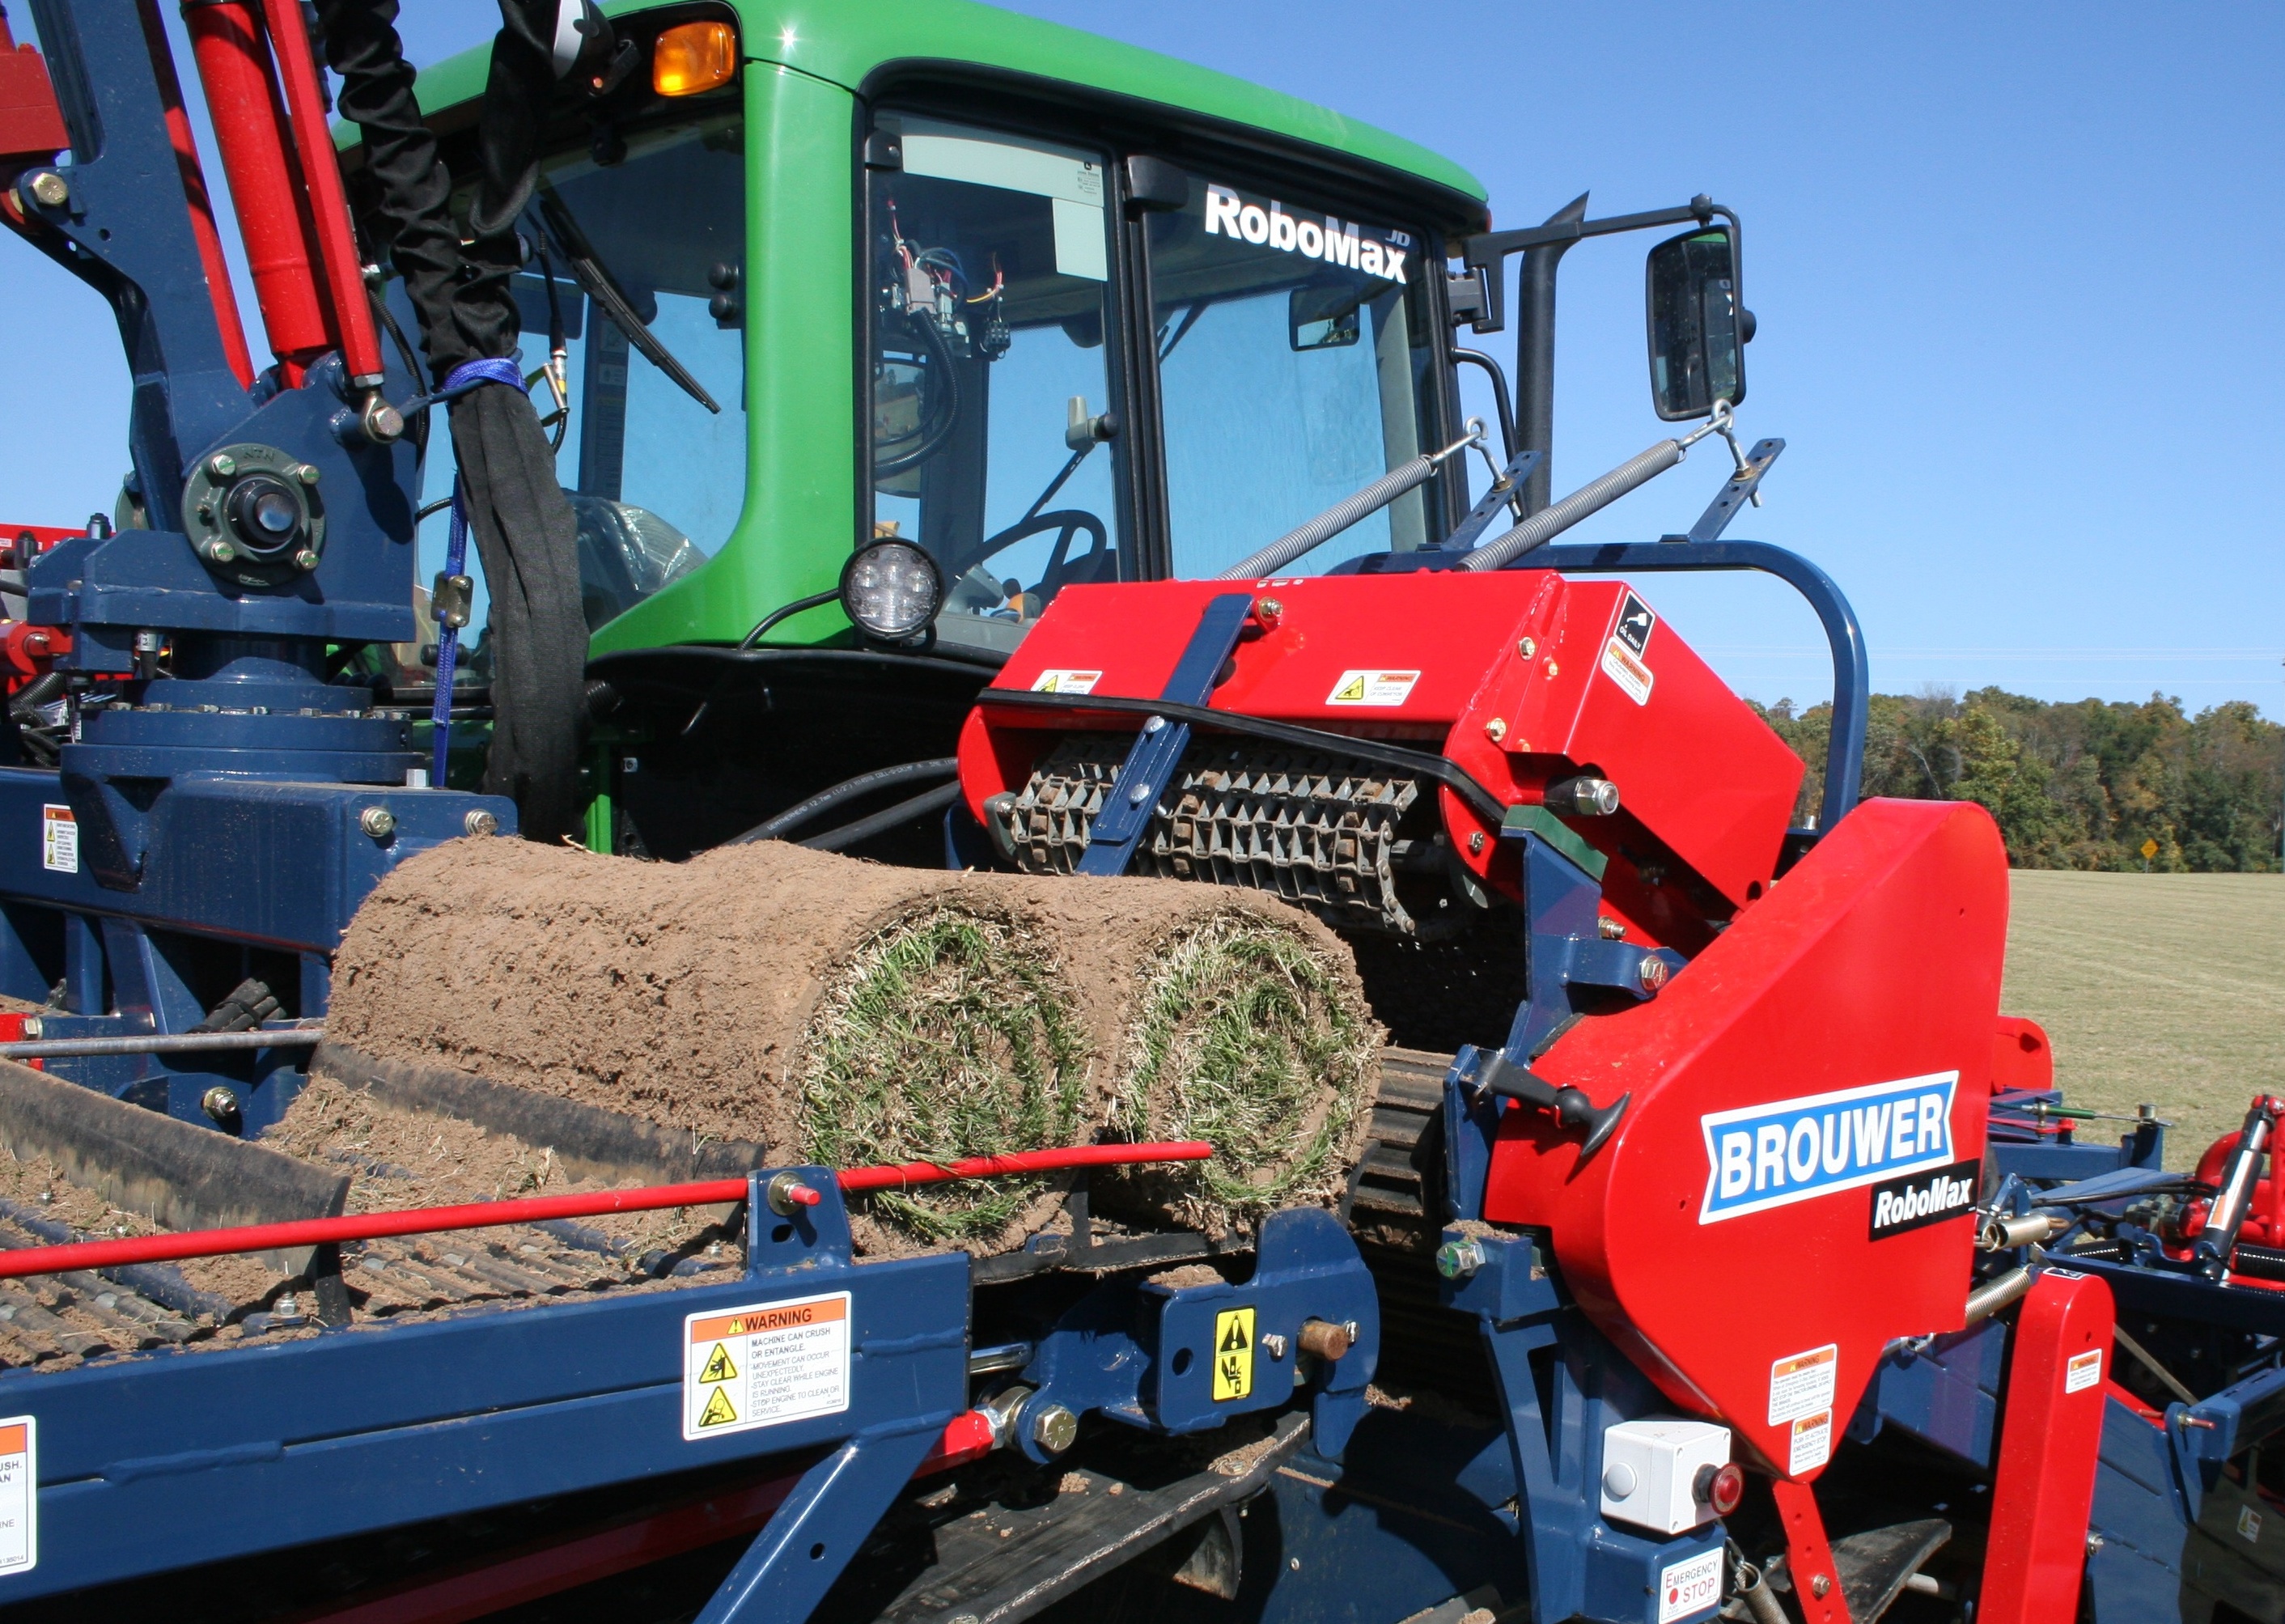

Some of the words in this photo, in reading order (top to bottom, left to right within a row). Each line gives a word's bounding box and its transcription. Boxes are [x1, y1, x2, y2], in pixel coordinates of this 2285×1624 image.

[1205, 183, 1407, 285] RoboMax
[1384, 229, 1410, 248] JD
[1627, 633, 1642, 650] DAILY
[1621, 655, 1645, 682] WARNING
[1720, 1093, 1944, 1200] BROUWER
[1874, 1175, 1973, 1229] RoboMax
[745, 1308, 812, 1333] WARNING
[752, 1333, 786, 1348] MACHINE
[787, 1331, 803, 1342] CAN
[806, 1327, 831, 1338] CRUSH
[752, 1350, 763, 1360] OR
[791, 1355, 806, 1364] CAN
[807, 1351, 830, 1361] OCCUR
[1796, 1355, 1820, 1369] WARNING
[770, 1376, 792, 1386] CLEAR
[814, 1367, 839, 1378] ENGINE
[772, 1393, 796, 1405] ENGINE
[797, 1391, 807, 1399] TO
[808, 1387, 829, 1397] CLEAN
[1802, 1414, 1829, 1431] WARNING
[1666, 1559, 1719, 1590] EMERGENCY
[1683, 1577, 1715, 1604] STOP
